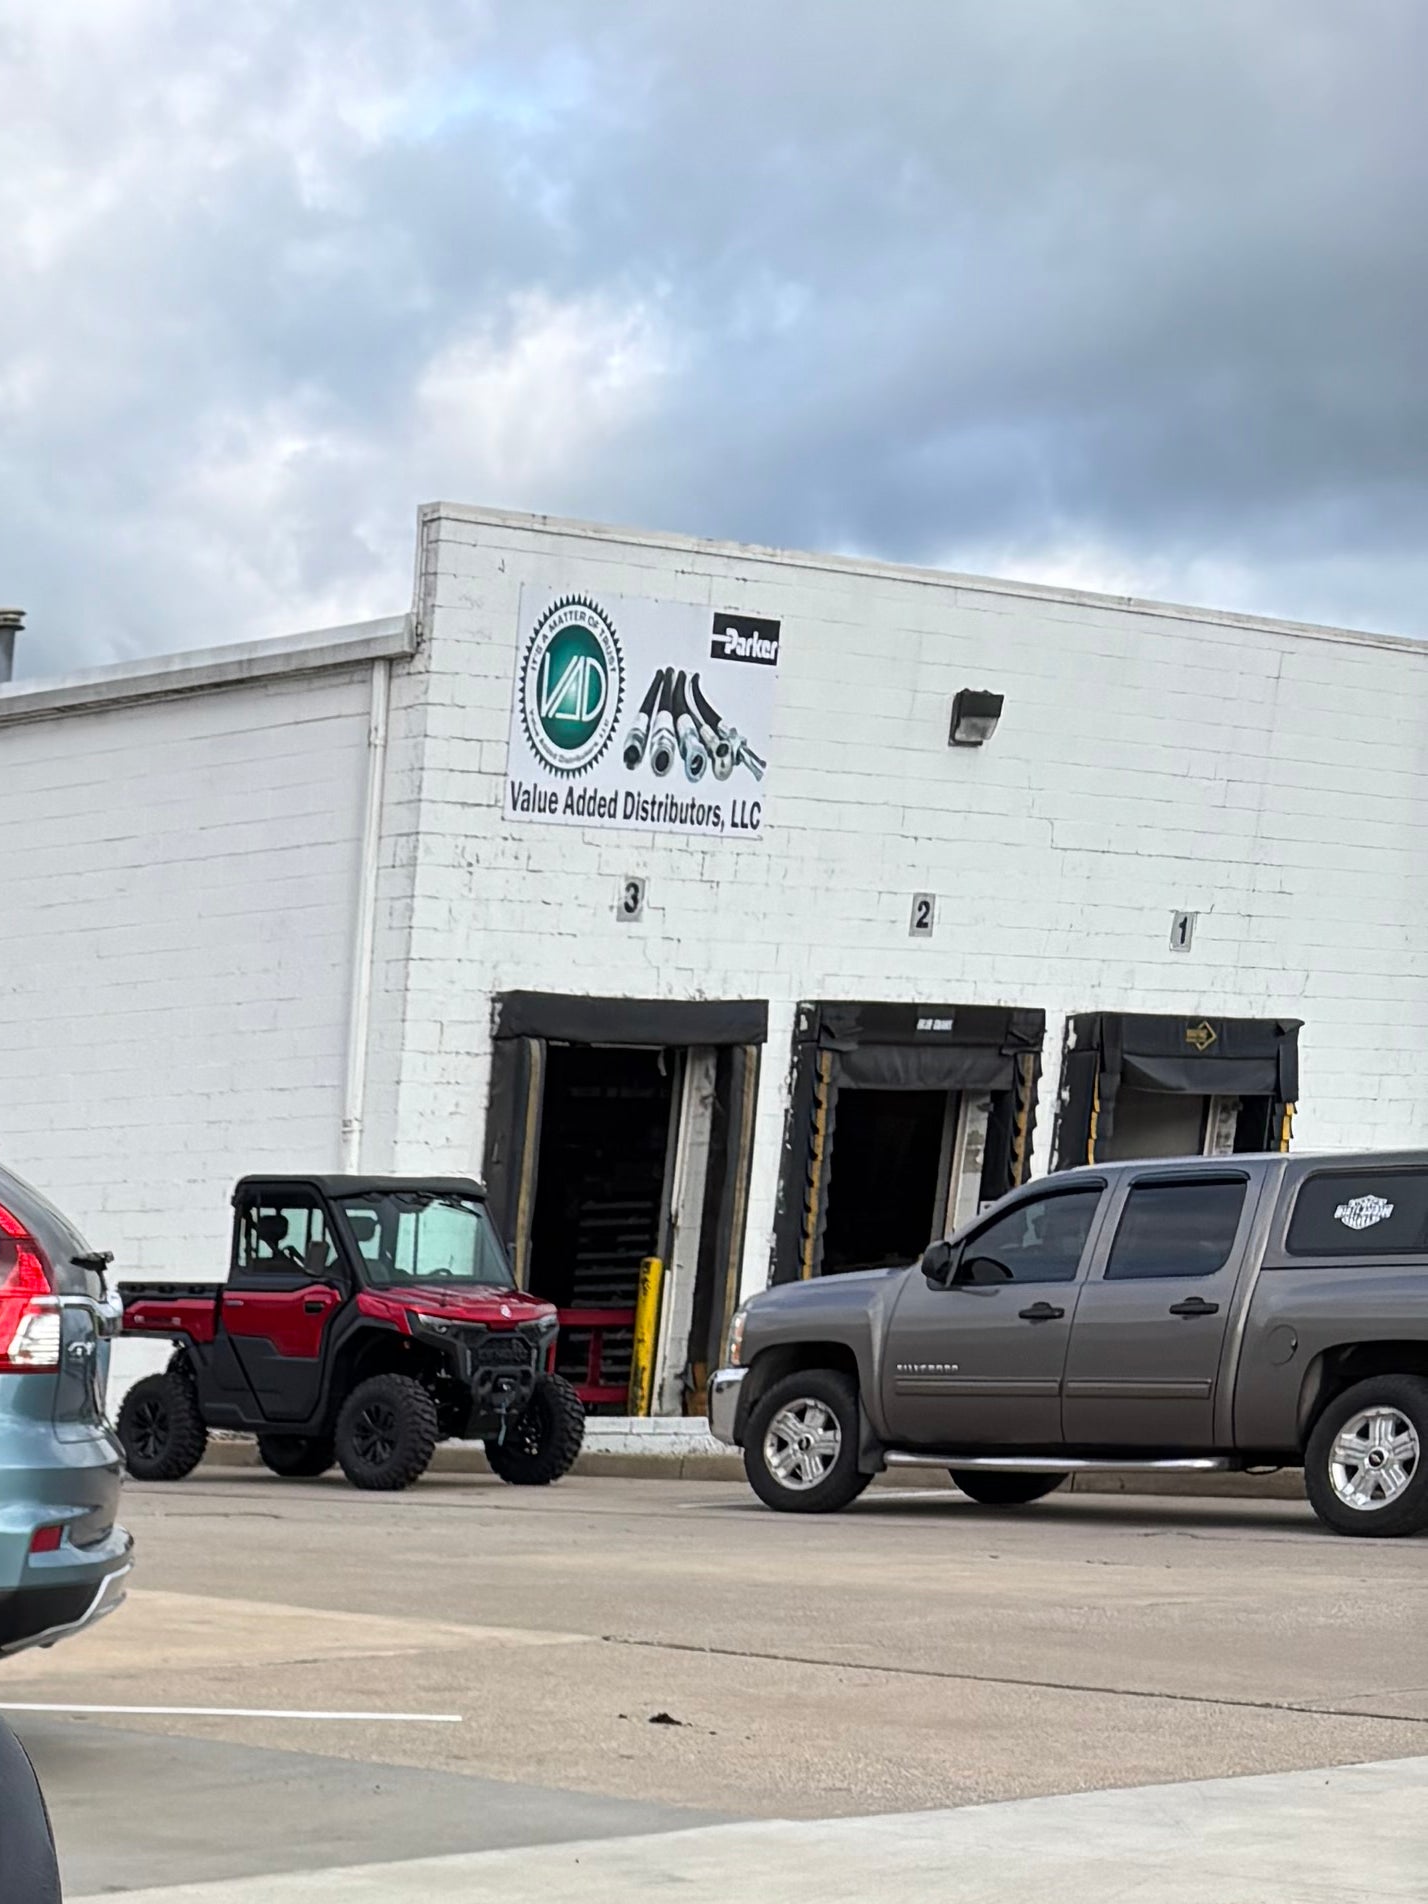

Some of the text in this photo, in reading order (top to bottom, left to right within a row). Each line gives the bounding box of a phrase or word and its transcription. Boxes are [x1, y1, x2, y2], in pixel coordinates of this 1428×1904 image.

[724, 627, 778, 661] Parker
[510, 781, 762, 832] Value Added Distributors, LLC
[624, 881, 640, 914] 3
[916, 900, 930, 930] 2
[1178, 916, 1189, 945] 1
